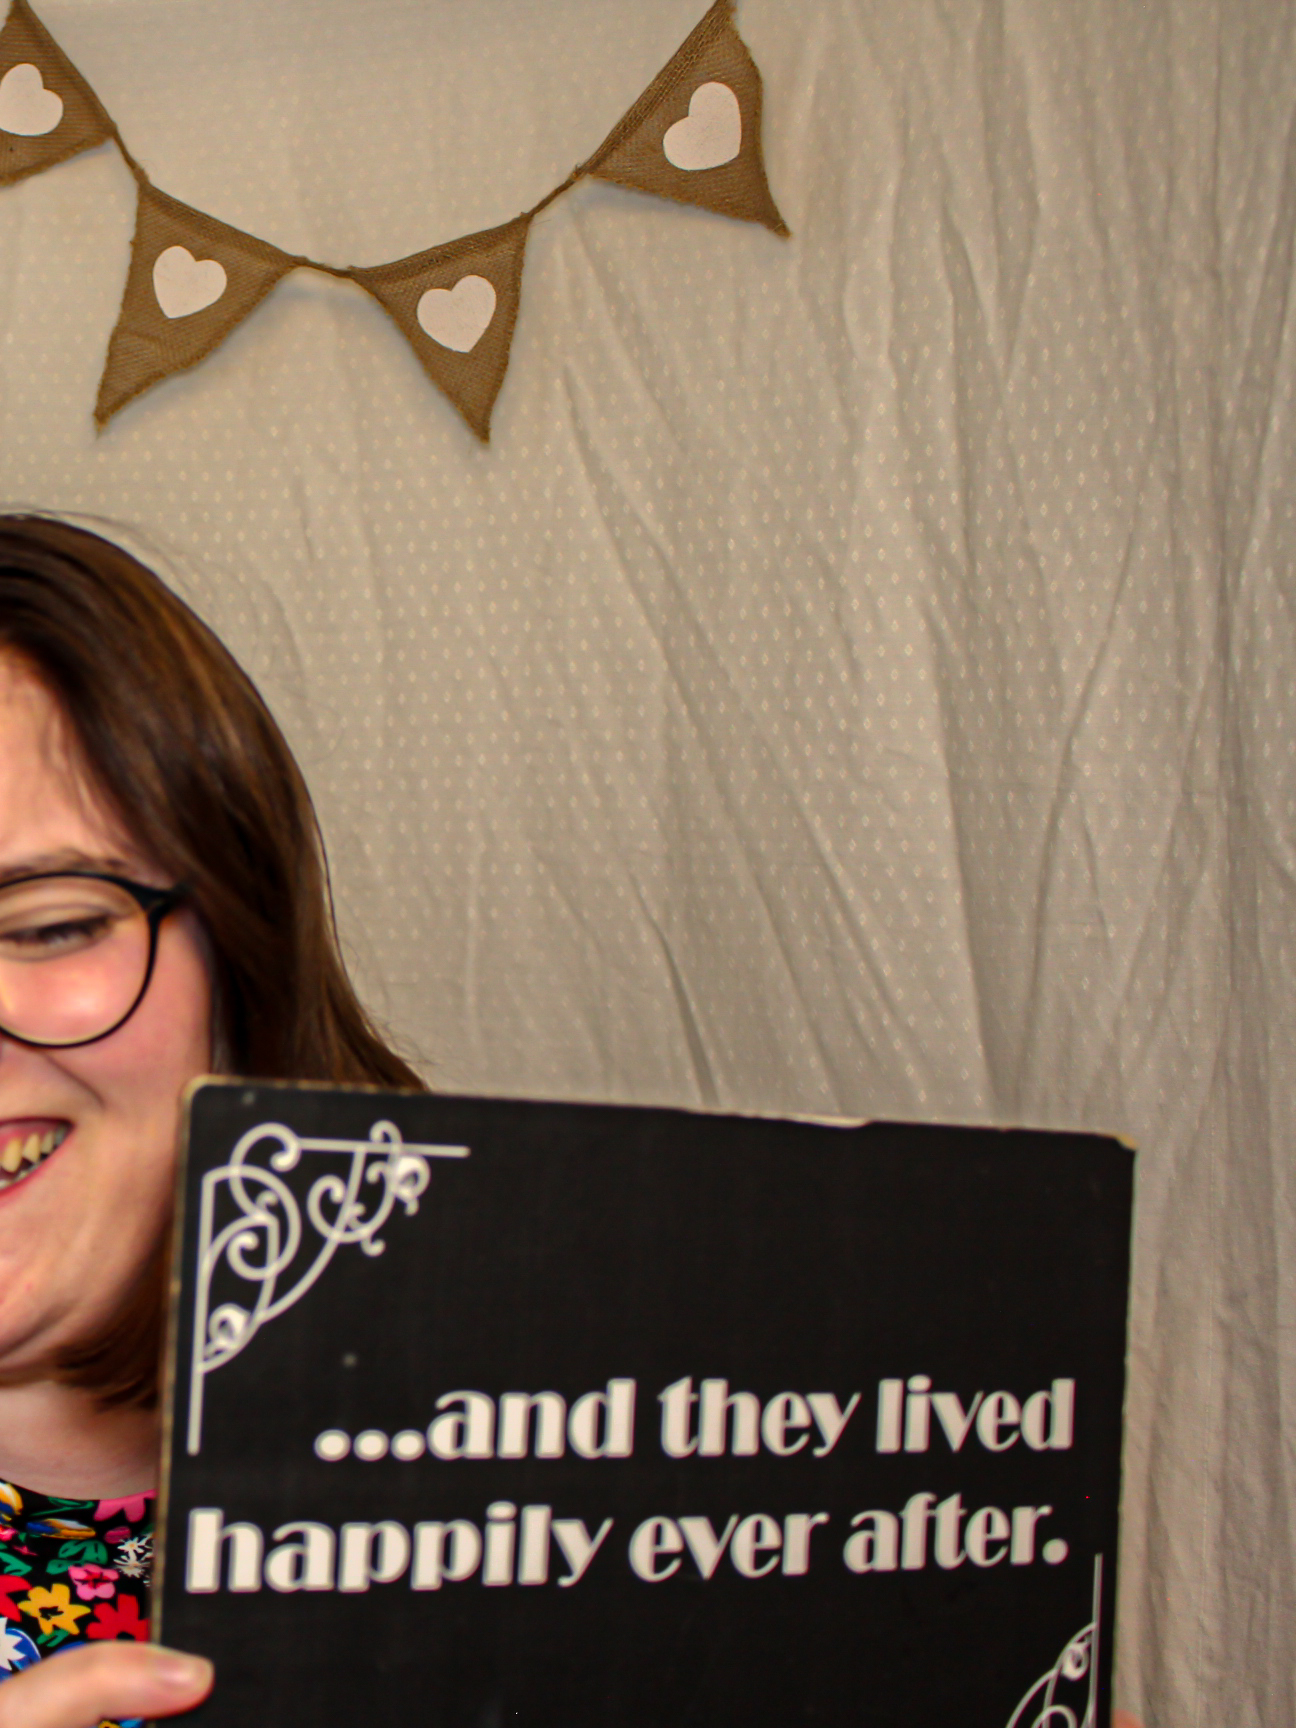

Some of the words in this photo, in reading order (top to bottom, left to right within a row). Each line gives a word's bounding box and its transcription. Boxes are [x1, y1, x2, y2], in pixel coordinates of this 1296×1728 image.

[658, 1377, 861, 1458] they
[876, 1375, 1075, 1453] lived
[185, 1501, 612, 1593] happily
[629, 1512, 828, 1582] ever
[844, 1492, 1068, 1573] after.
